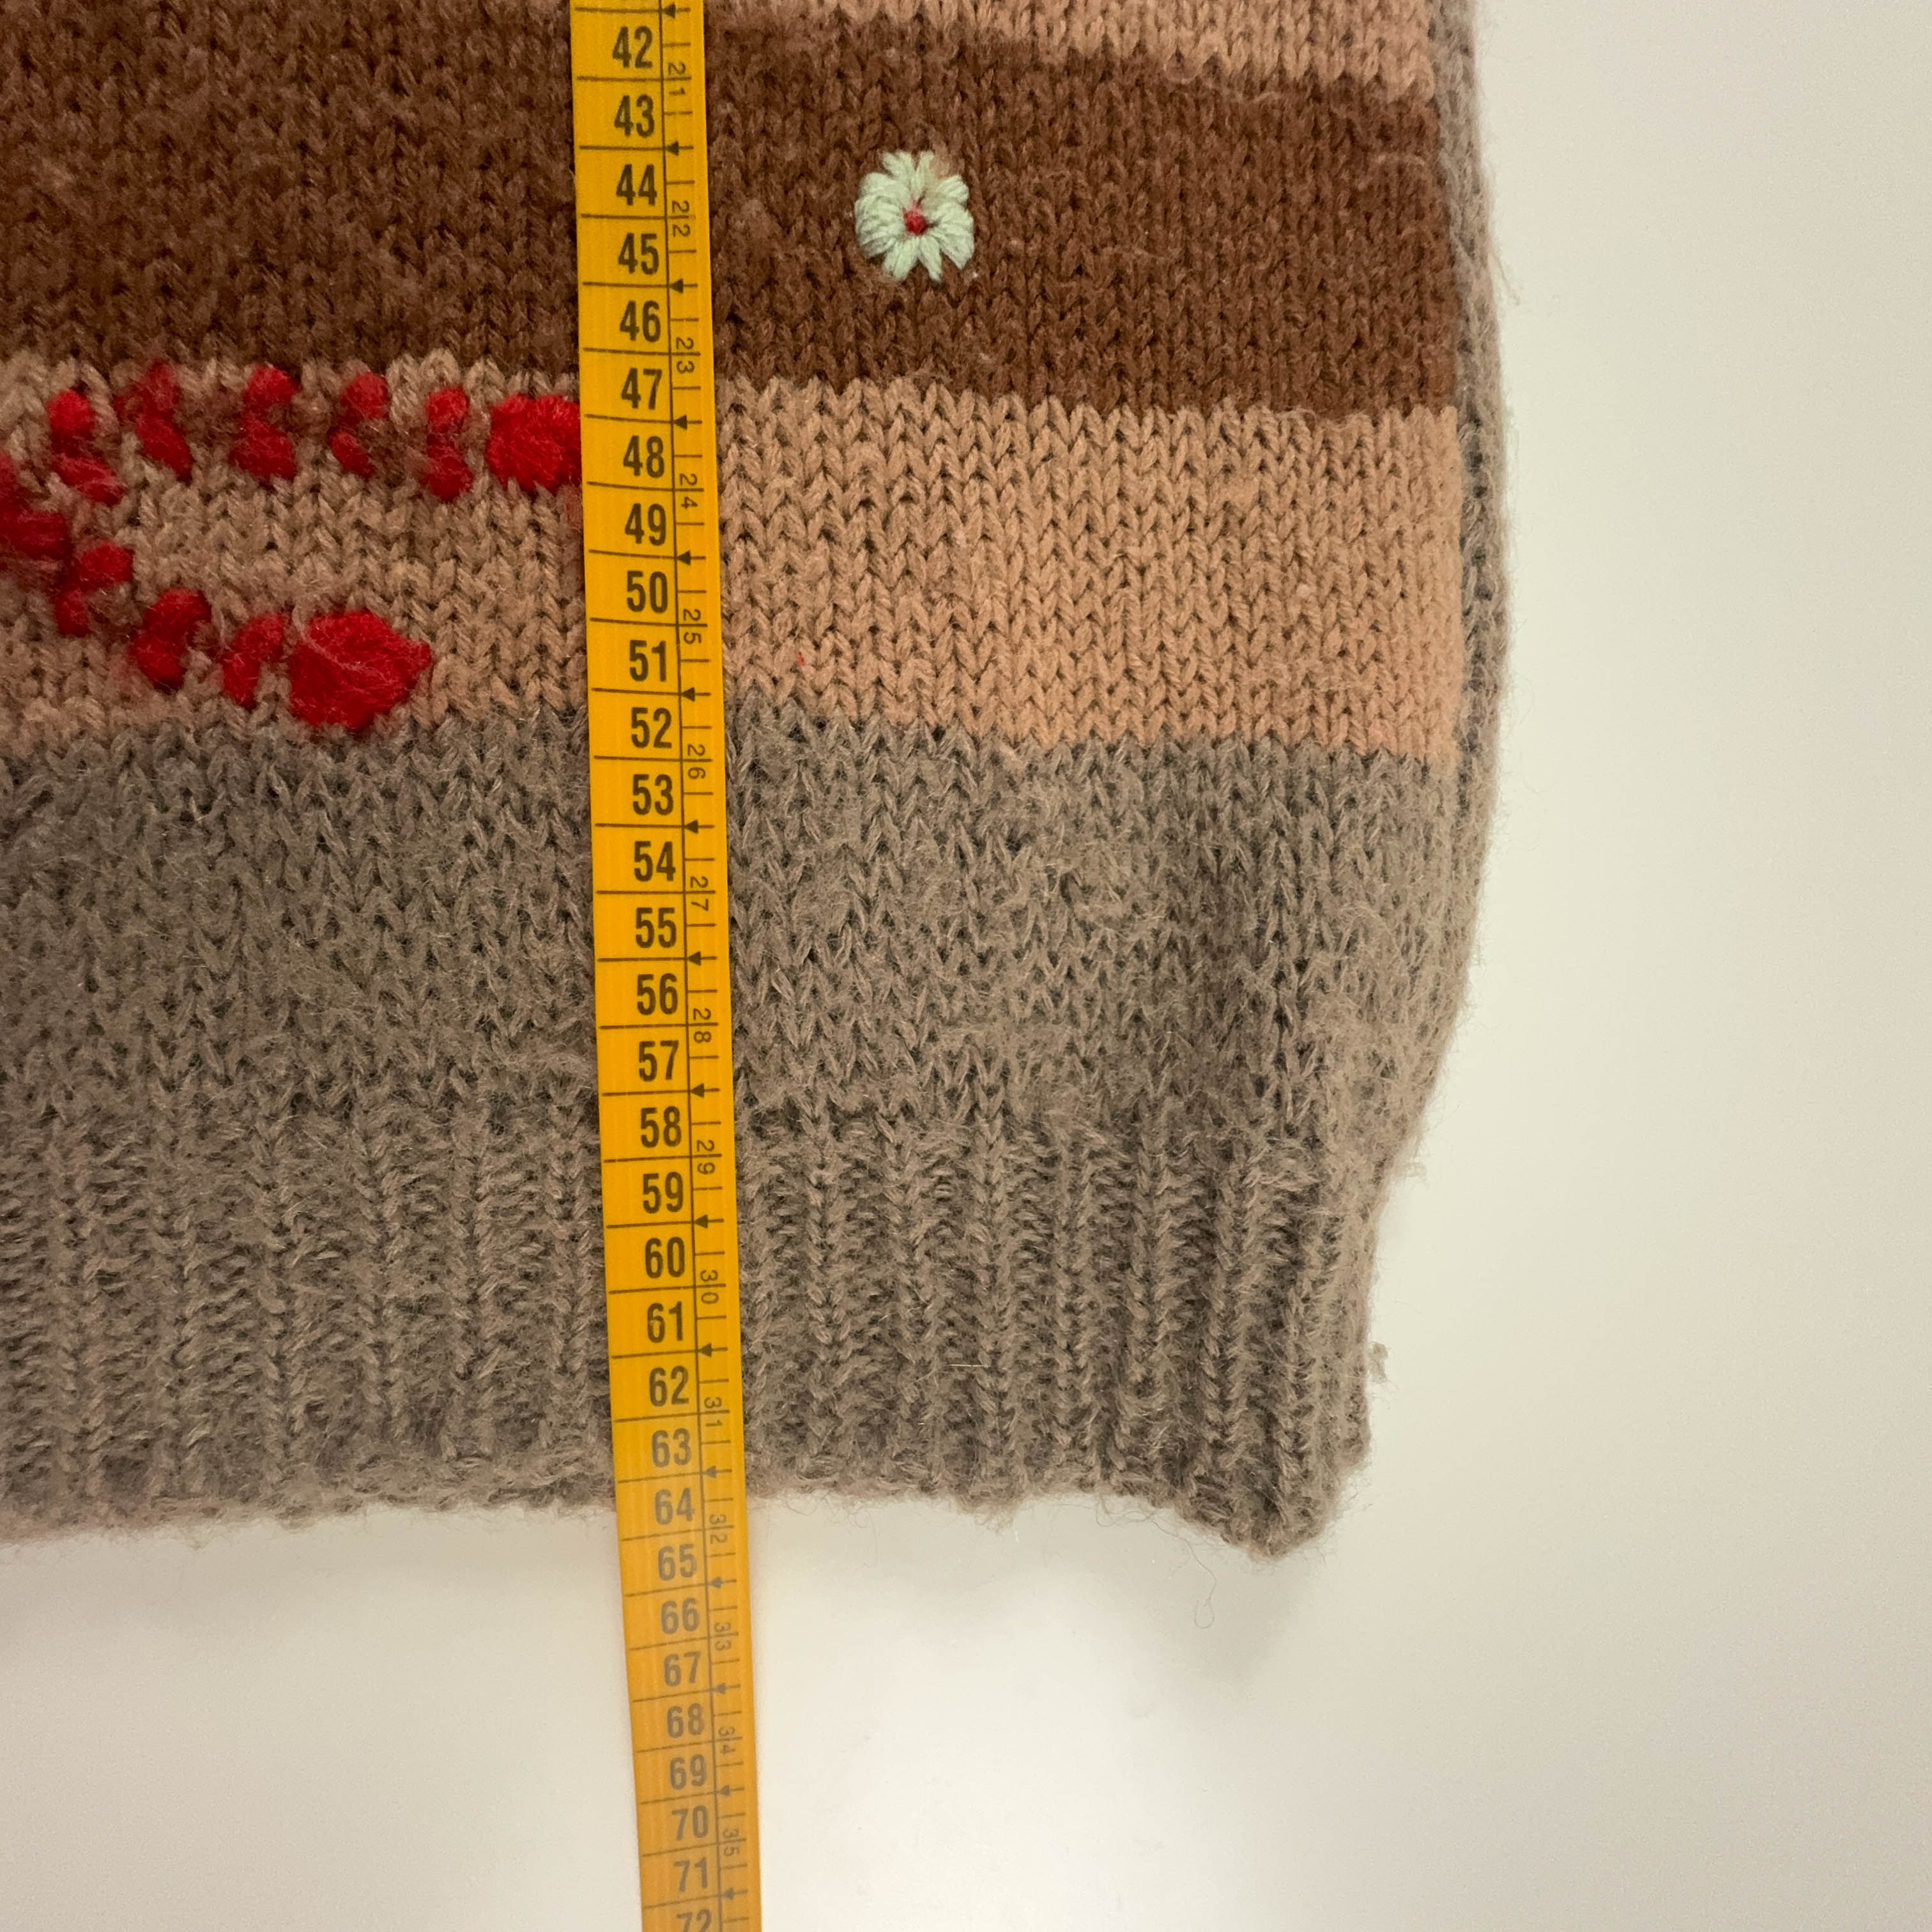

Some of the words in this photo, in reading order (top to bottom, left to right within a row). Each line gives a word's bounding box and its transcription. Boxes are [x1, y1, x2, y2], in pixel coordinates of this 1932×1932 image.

[612, 26, 653, 68] 42
[668, 63, 686, 95] 21
[614, 95, 655, 137] 43
[616, 164, 657, 206] 44
[671, 200, 691, 237] 22
[618, 233, 659, 275] 45
[620, 300, 661, 342] 46
[676, 337, 695, 374] 23
[621, 368, 663, 410] 47
[623, 436, 664, 478] 48
[680, 473, 698, 509] 24
[625, 503, 666, 546] 49
[627, 570, 668, 613] 50
[683, 609, 701, 645] 25
[629, 640, 666, 682] 51
[631, 707, 672, 748] 52
[687, 744, 705, 779] 26
[632, 774, 674, 815] 53
[634, 841, 676, 882] 54
[690, 876, 709, 911] 27
[635, 907, 677, 949] 55
[637, 973, 678, 1015] 56
[693, 1008, 712, 1043] 28
[639, 1040, 679, 1082] 57
[640, 1107, 682, 1148] 58
[697, 1140, 715, 1175] 29
[643, 1172, 683, 1214] 59
[645, 1237, 686, 1278] 60
[700, 1269, 718, 1305] 30
[647, 1301, 684, 1343] 61
[649, 1365, 689, 1407] 62
[704, 1396, 723, 1428] 31
[652, 1428, 692, 1468] 63
[654, 1487, 695, 1525] 64
[709, 1514, 728, 1544] 32
[657, 1544, 696, 1581] 65
[661, 1598, 700, 1634] 66
[664, 1651, 702, 1687] 67
[667, 1703, 705, 1738] 68
[670, 1754, 707, 1790] 69
[671, 1805, 709, 1841] 70
[673, 1857, 709, 1892] 71
[676, 1909, 712, 1932] 72
